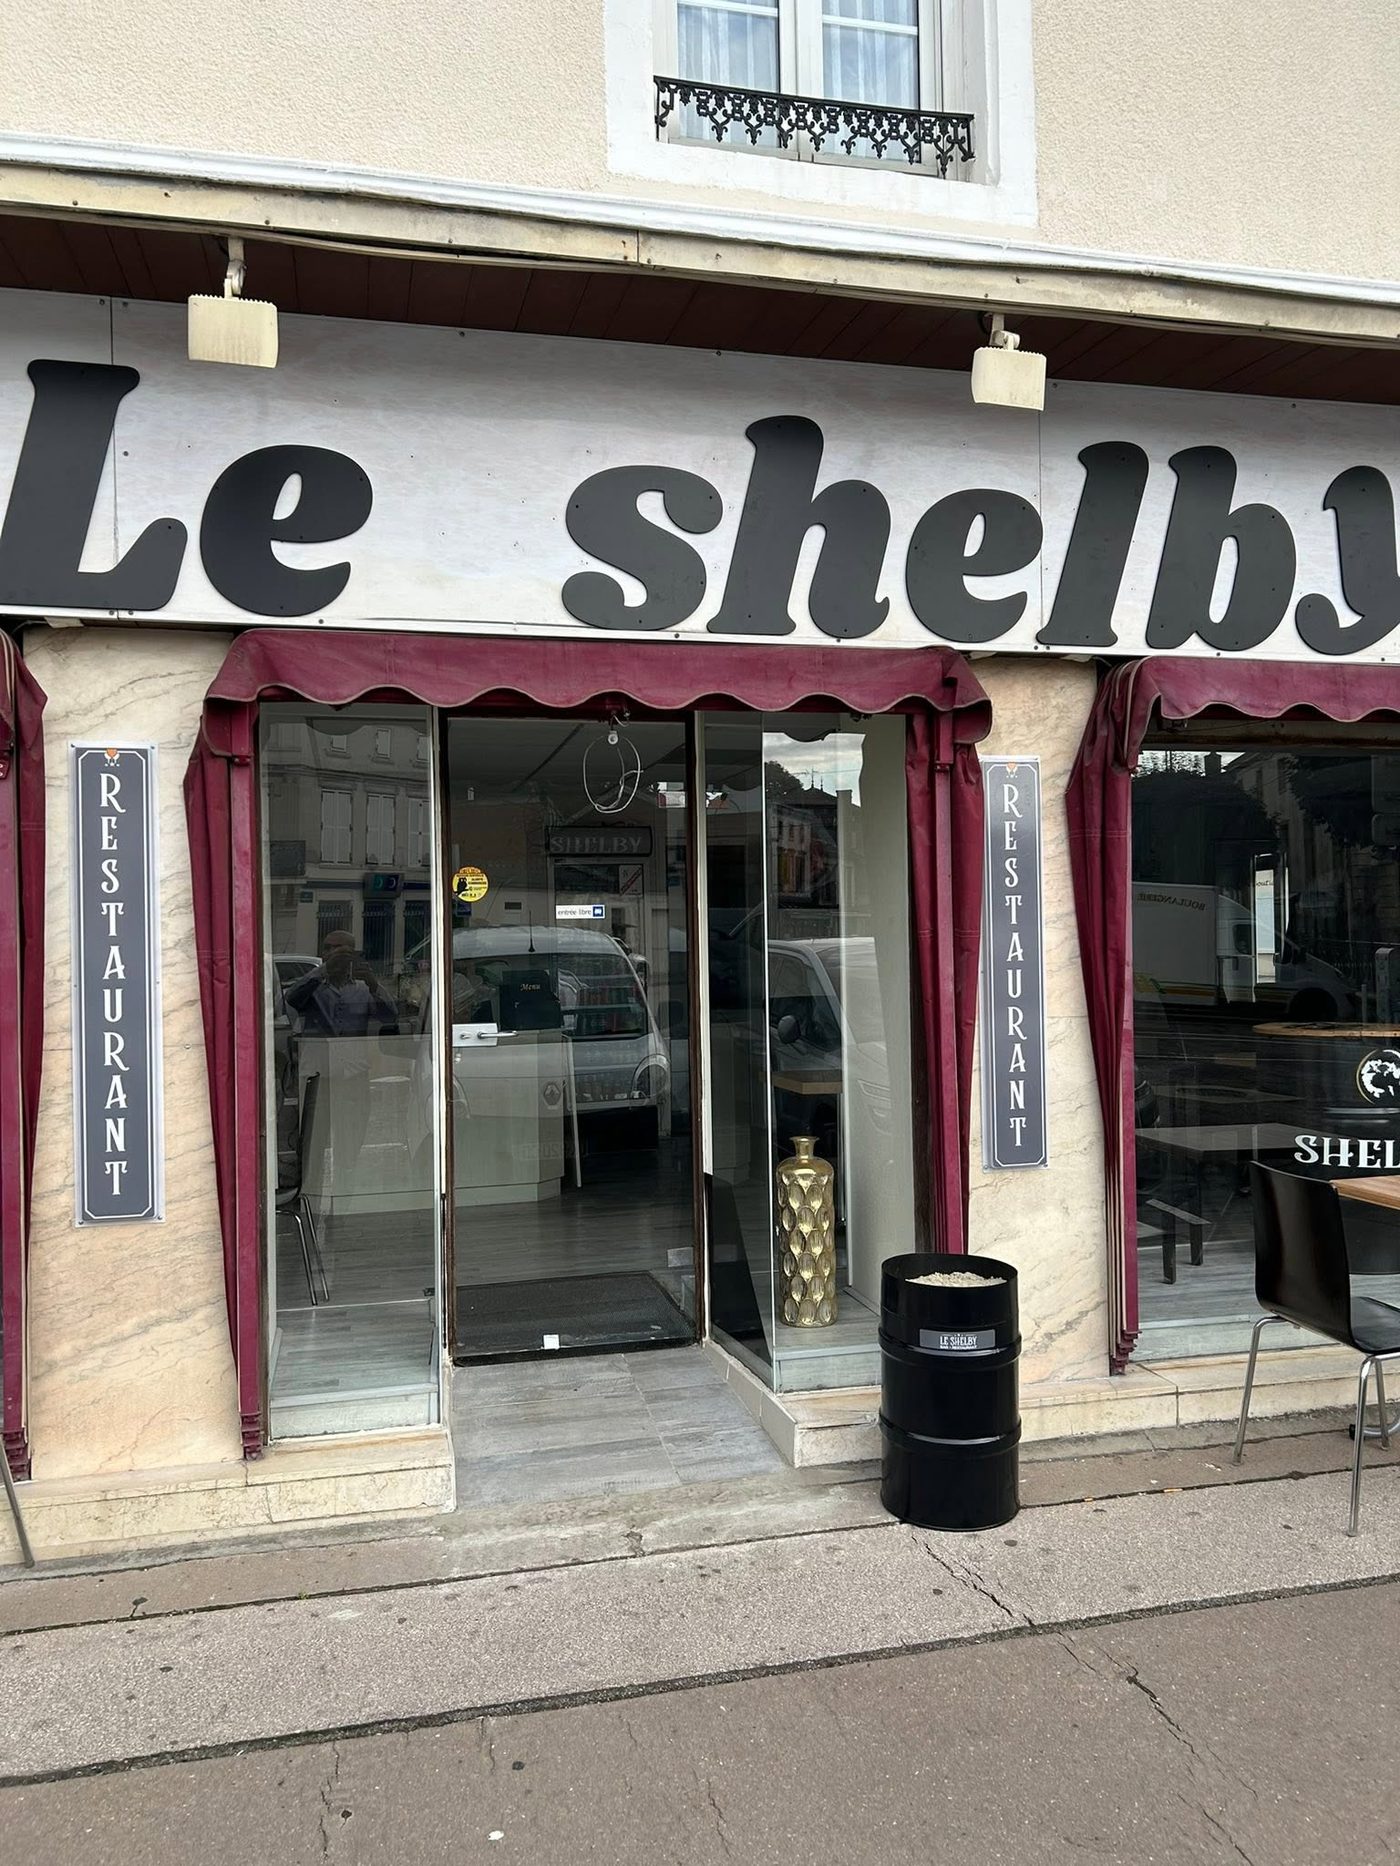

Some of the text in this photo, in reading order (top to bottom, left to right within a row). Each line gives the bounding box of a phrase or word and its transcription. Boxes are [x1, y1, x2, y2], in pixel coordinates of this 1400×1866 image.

[0, 359, 373, 617] Le
[578, 908, 592, 916] libre
[1003, 783, 1027, 1148] RESTAURANT
[100, 773, 128, 1196] RESTAURANT
[520, 983, 541, 992] Menu
[940, 1335, 978, 1346] LE SHELBY
